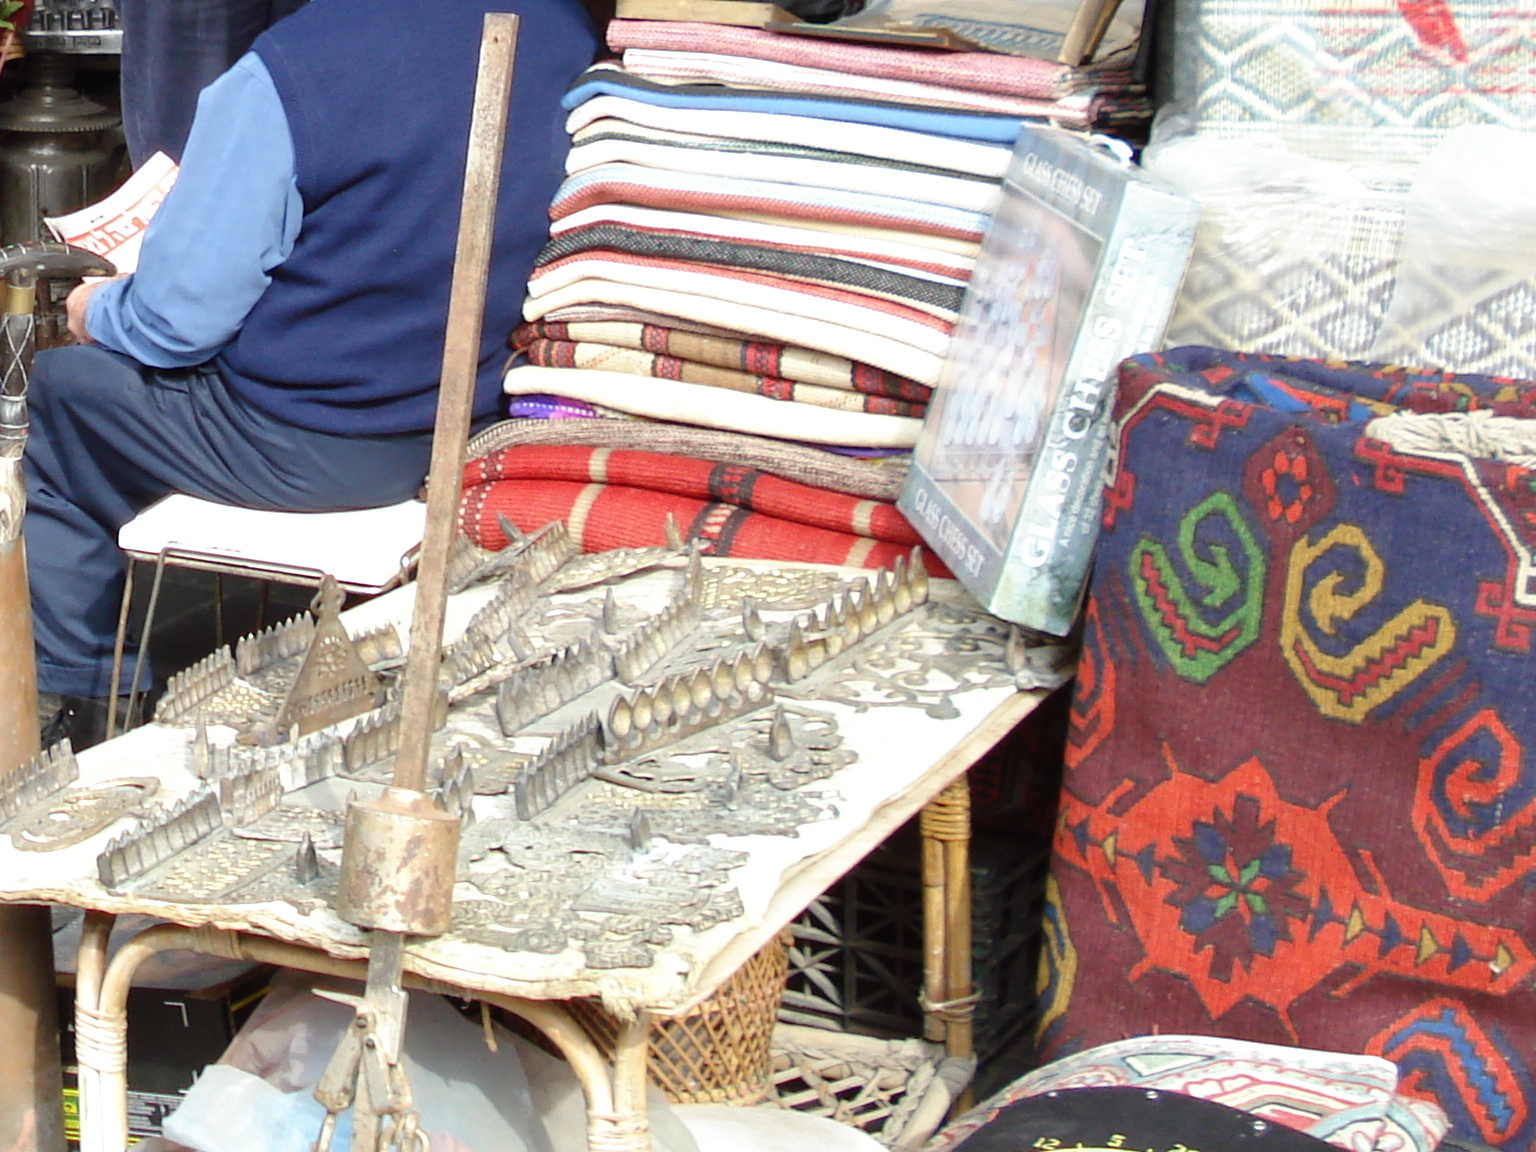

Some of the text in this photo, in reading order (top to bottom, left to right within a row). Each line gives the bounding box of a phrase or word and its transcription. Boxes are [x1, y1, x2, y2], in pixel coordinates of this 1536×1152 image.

[1024, 153, 1103, 215] GLASS CHESS SET
[1020, 449, 1078, 568] GLASS
[1063, 315, 1122, 439] CHESS
[1105, 237, 1148, 307] SET
[915, 488, 985, 577] GLASS CHESS SET
[1032, 1137, 1062, 1150] 12
[1106, 1134, 1127, 1148] 5
